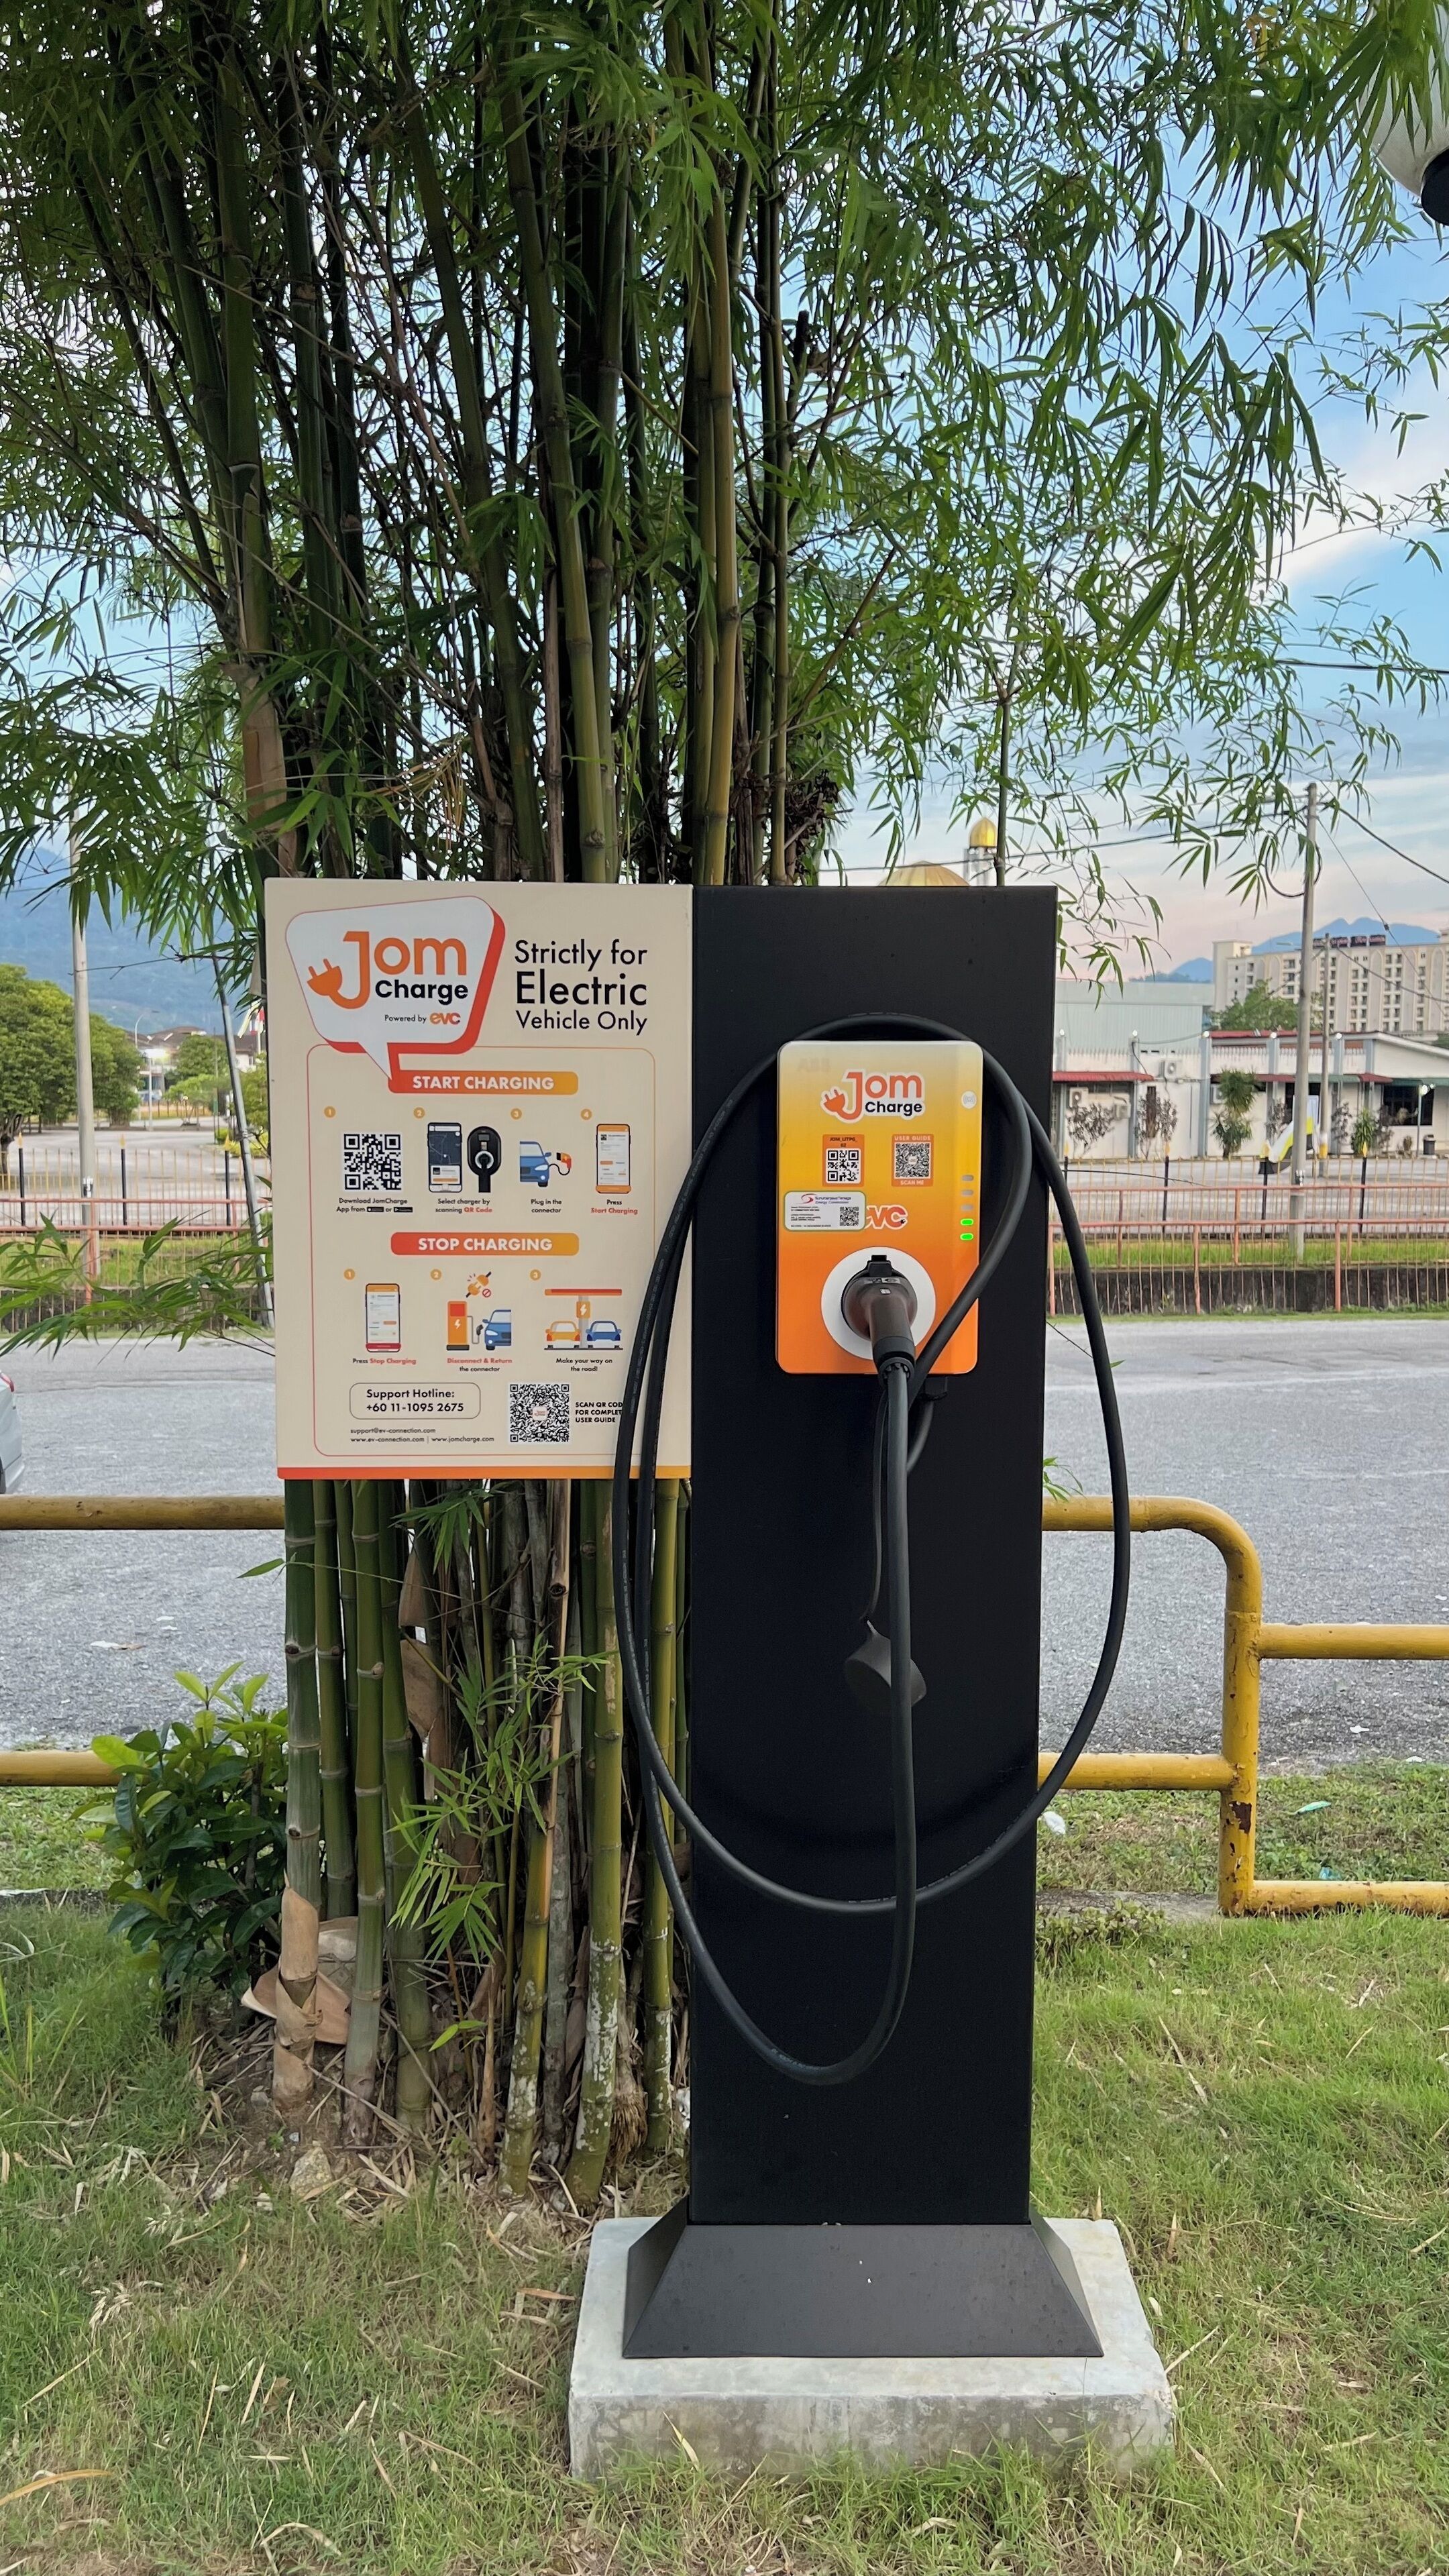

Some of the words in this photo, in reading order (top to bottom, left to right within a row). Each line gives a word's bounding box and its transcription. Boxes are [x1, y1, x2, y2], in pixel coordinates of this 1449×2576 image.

[515, 939, 602, 971] Strictly
[611, 939, 647, 965] for
[331, 930, 467, 1010] Jom
[375, 979, 468, 1006] Charge
[516, 970, 647, 1006] Electric
[417, 1014, 427, 1024] by
[516, 1010, 590, 1030] Vehicle
[598, 1010, 647, 1036] Only
[413, 1076, 460, 1090] START
[464, 1076, 555, 1091] CHARGING
[838, 1071, 923, 1120] Jom
[865, 1101, 923, 1117] Charge
[372, 1197, 408, 1205] JomCharge
[457, 1198, 481, 1206] charger
[418, 1237, 460, 1251] STOP
[463, 1237, 553, 1252] CHARGING
[386, 1358, 417, 1366] Charging
[366, 1389, 410, 1401] Support
[413, 1388, 455, 1398] Hotline:
[366, 1403, 387, 1412] +60
[390, 1403, 433, 1412] 11-1095
[437, 1403, 464, 1412] 2675
[350, 1427, 436, 1435] support@ev-connection.com
[431, 1436, 494, 1444] www.jomcharge.com
